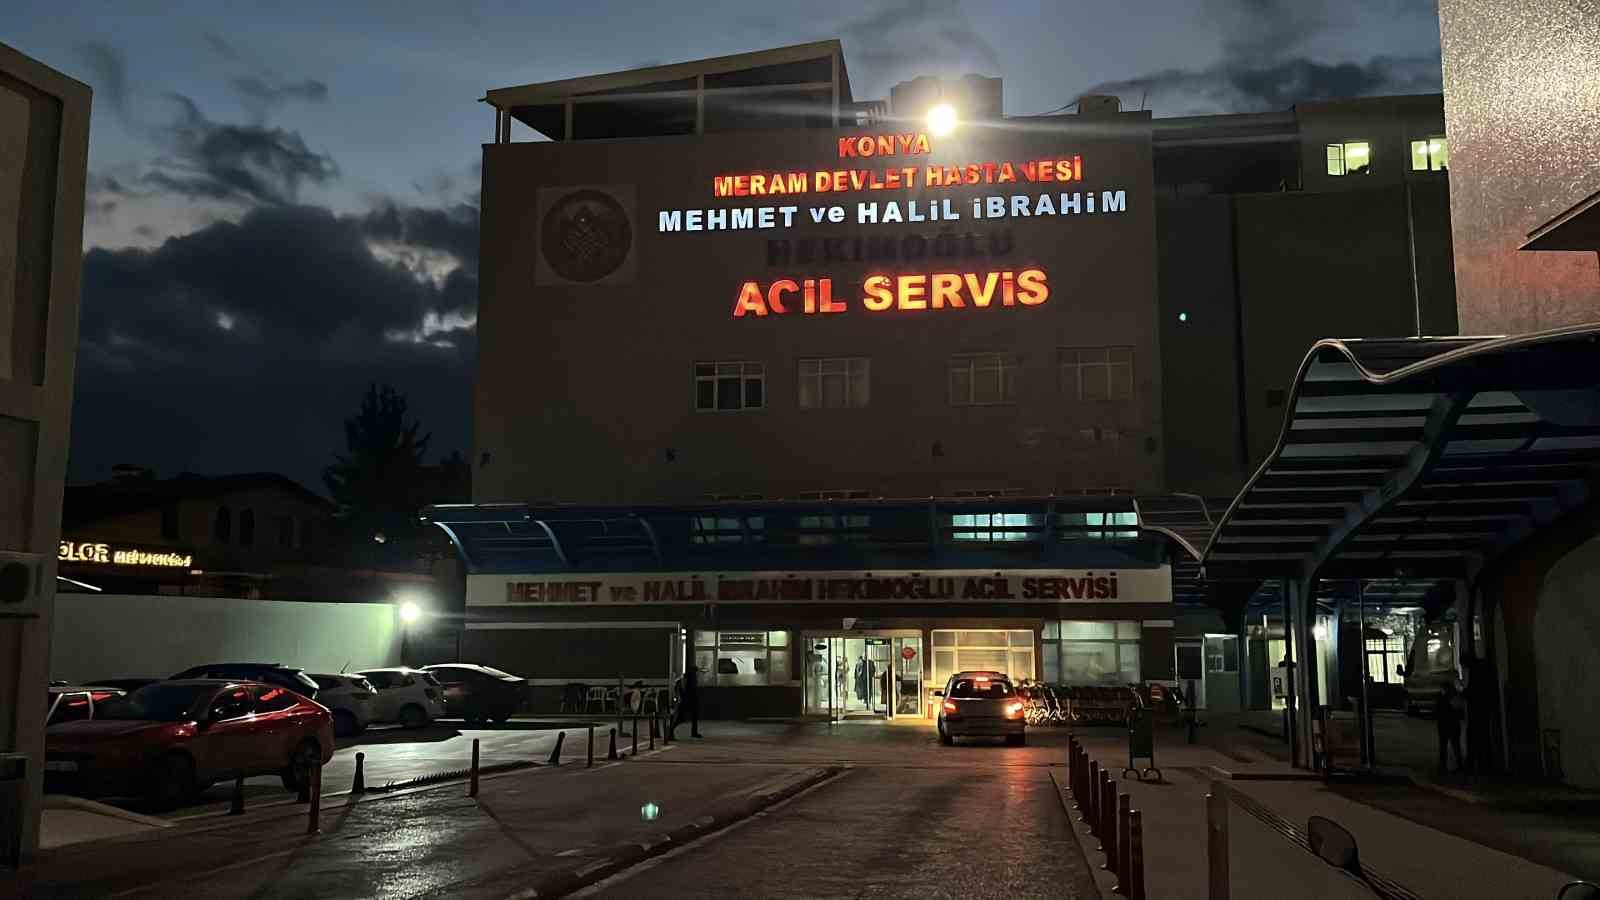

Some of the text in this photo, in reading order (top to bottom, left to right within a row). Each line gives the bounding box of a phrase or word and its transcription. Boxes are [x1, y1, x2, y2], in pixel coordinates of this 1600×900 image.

[838, 134, 932, 158] KONYA
[713, 172, 808, 198] MERAM
[814, 168, 917, 194] DEVLET
[658, 206, 798, 232] MEHMET
[809, 206, 845, 223] ve
[507, 581, 603, 602] MEHMET
[1021, 572, 1119, 600] SERVİSİ
